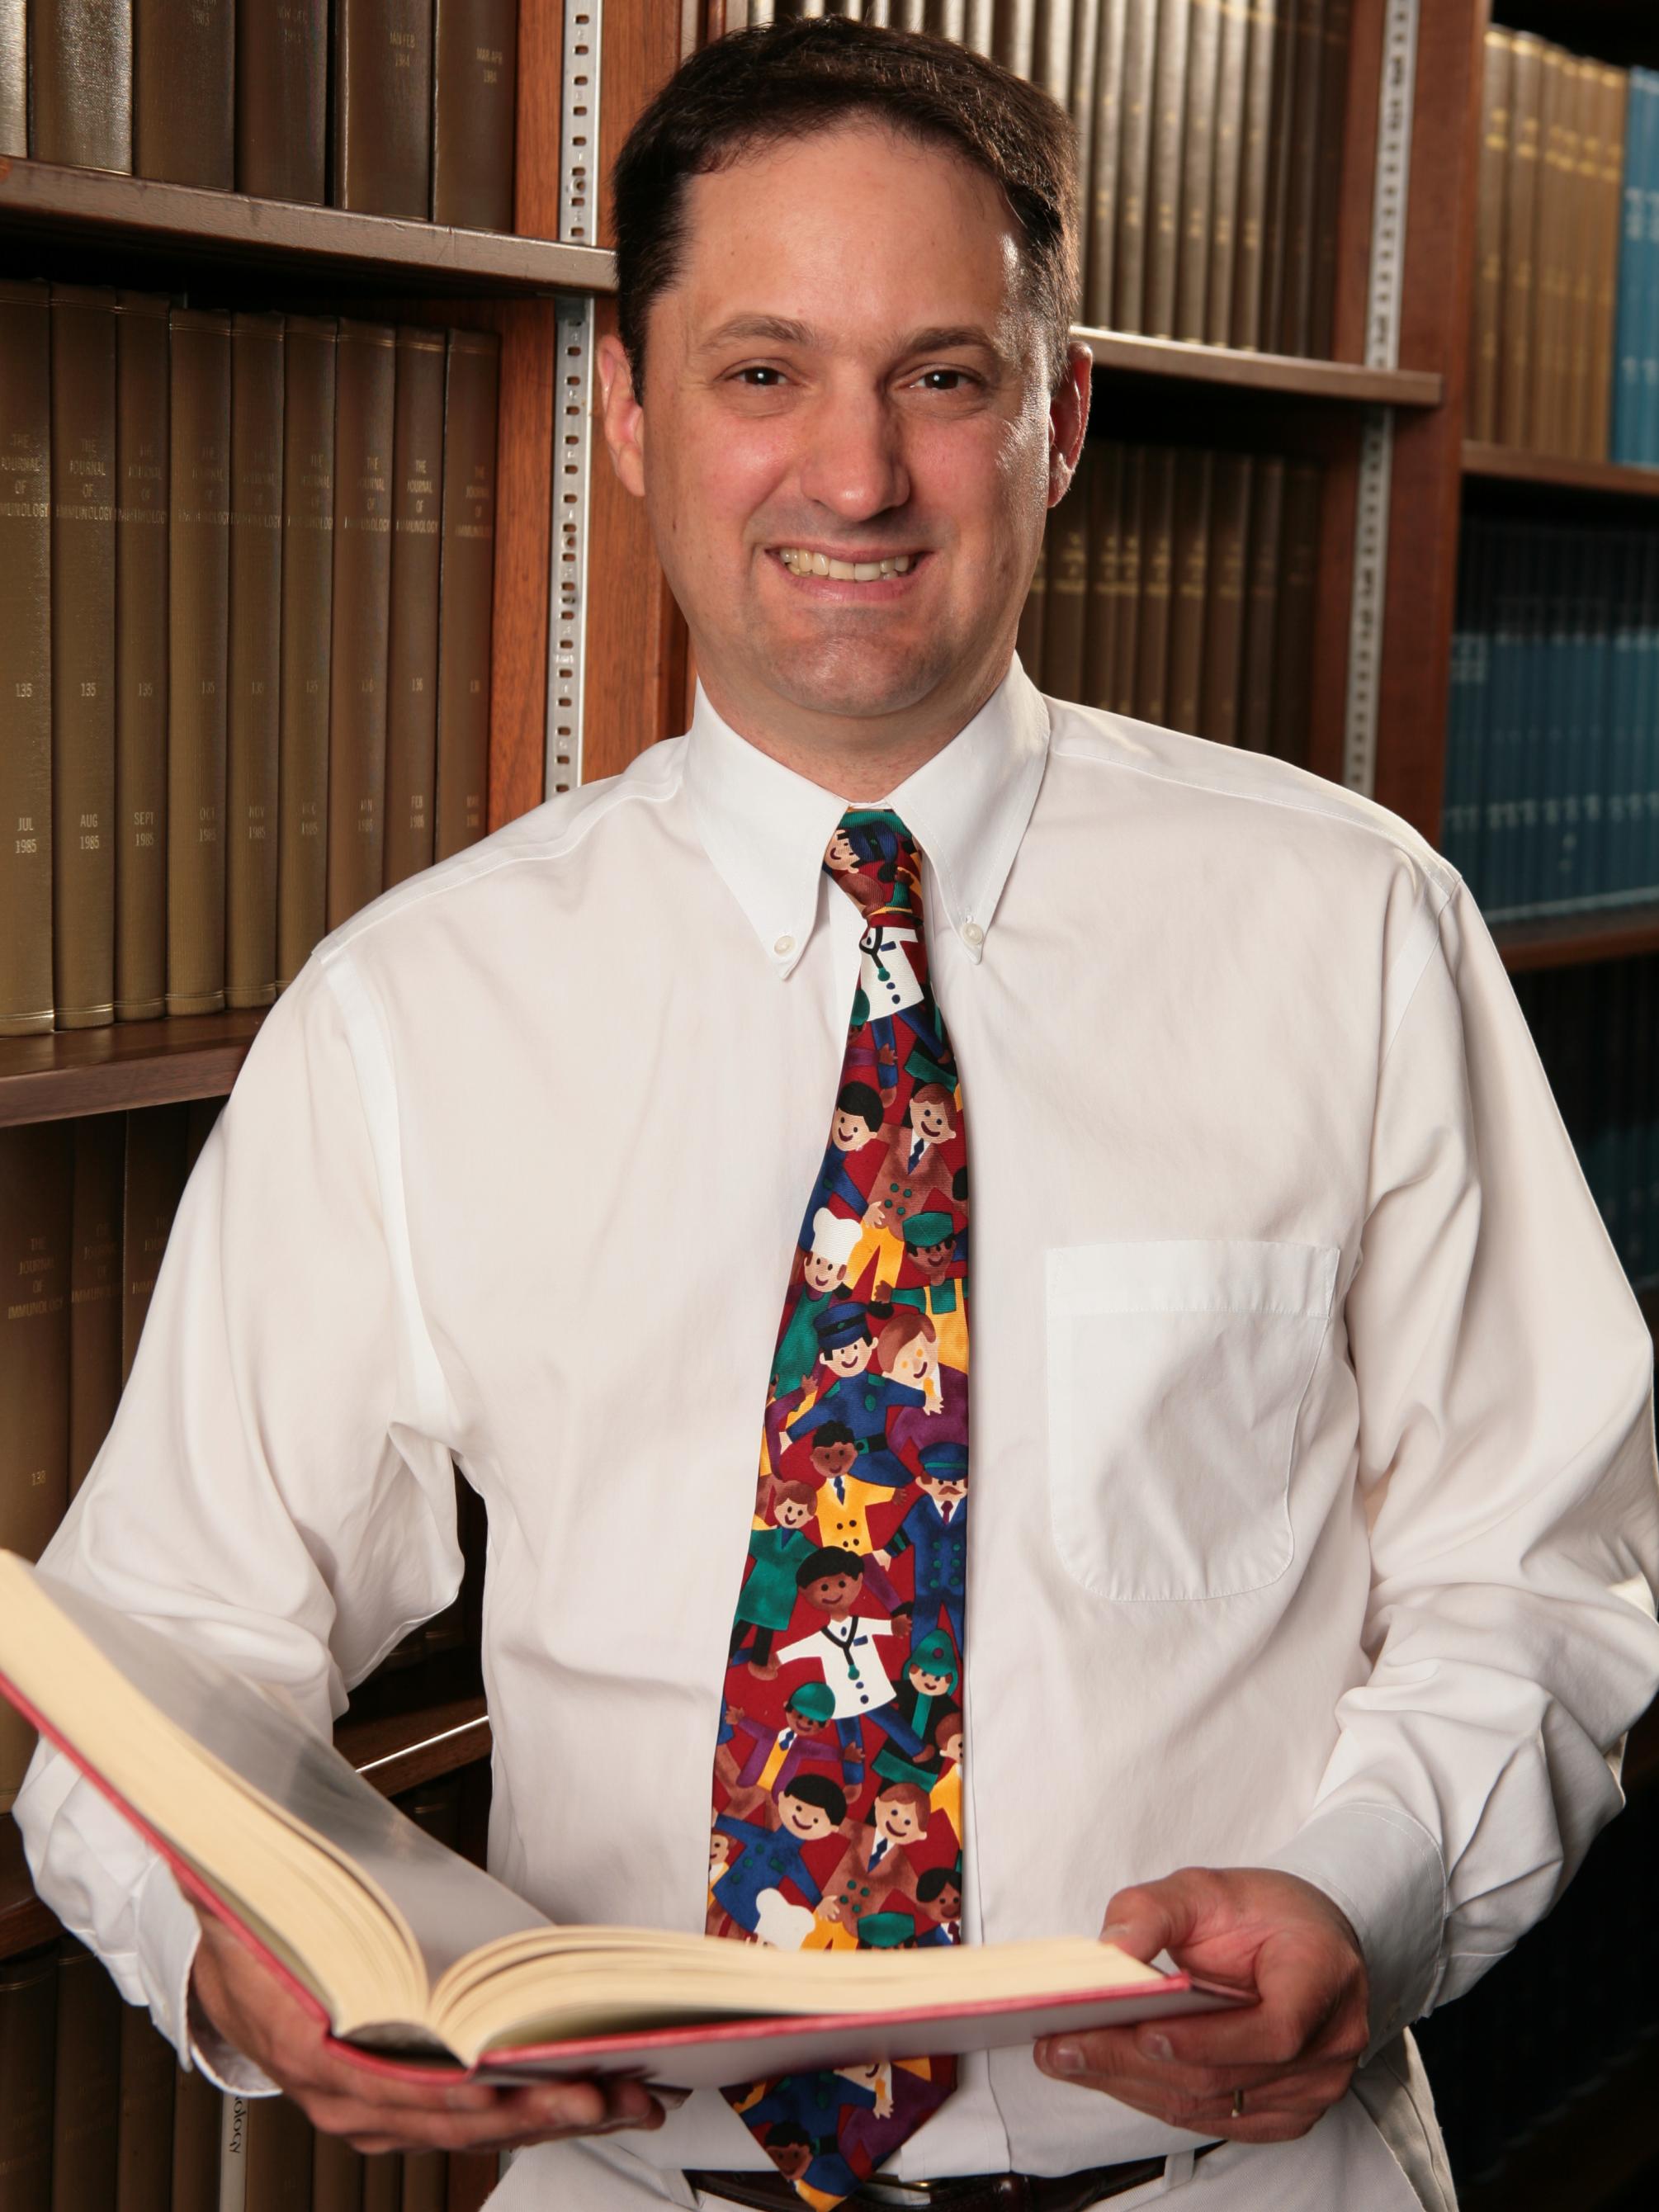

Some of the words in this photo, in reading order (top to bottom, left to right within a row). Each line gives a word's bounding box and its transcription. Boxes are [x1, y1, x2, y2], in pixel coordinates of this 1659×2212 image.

[69, 459, 106, 476] JOURNAL
[415, 459, 428, 475] THE
[15, 479, 27, 495] OF
[82, 483, 93, 499] OF
[406, 479, 434, 494] JOURNAL
[415, 499, 425, 514] OF
[15, 681, 34, 698] 135
[80, 681, 97, 698] 135
[138, 682, 154, 697] 135
[410, 794, 424, 811] FEB
[17, 816, 35, 832] JUL
[79, 812, 98, 829] AUG
[133, 810, 155, 827] SEPT
[14, 838, 38, 855] 1985
[78, 834, 101, 851] 1985
[134, 831, 154, 848] 1985
[18, 1256, 56, 1275] JOURNAL
[32, 1279, 46, 1294] OF
[7, 1296, 64, 1321] IMMUNOLOGY
[229, 2096, 247, 2153] ology
